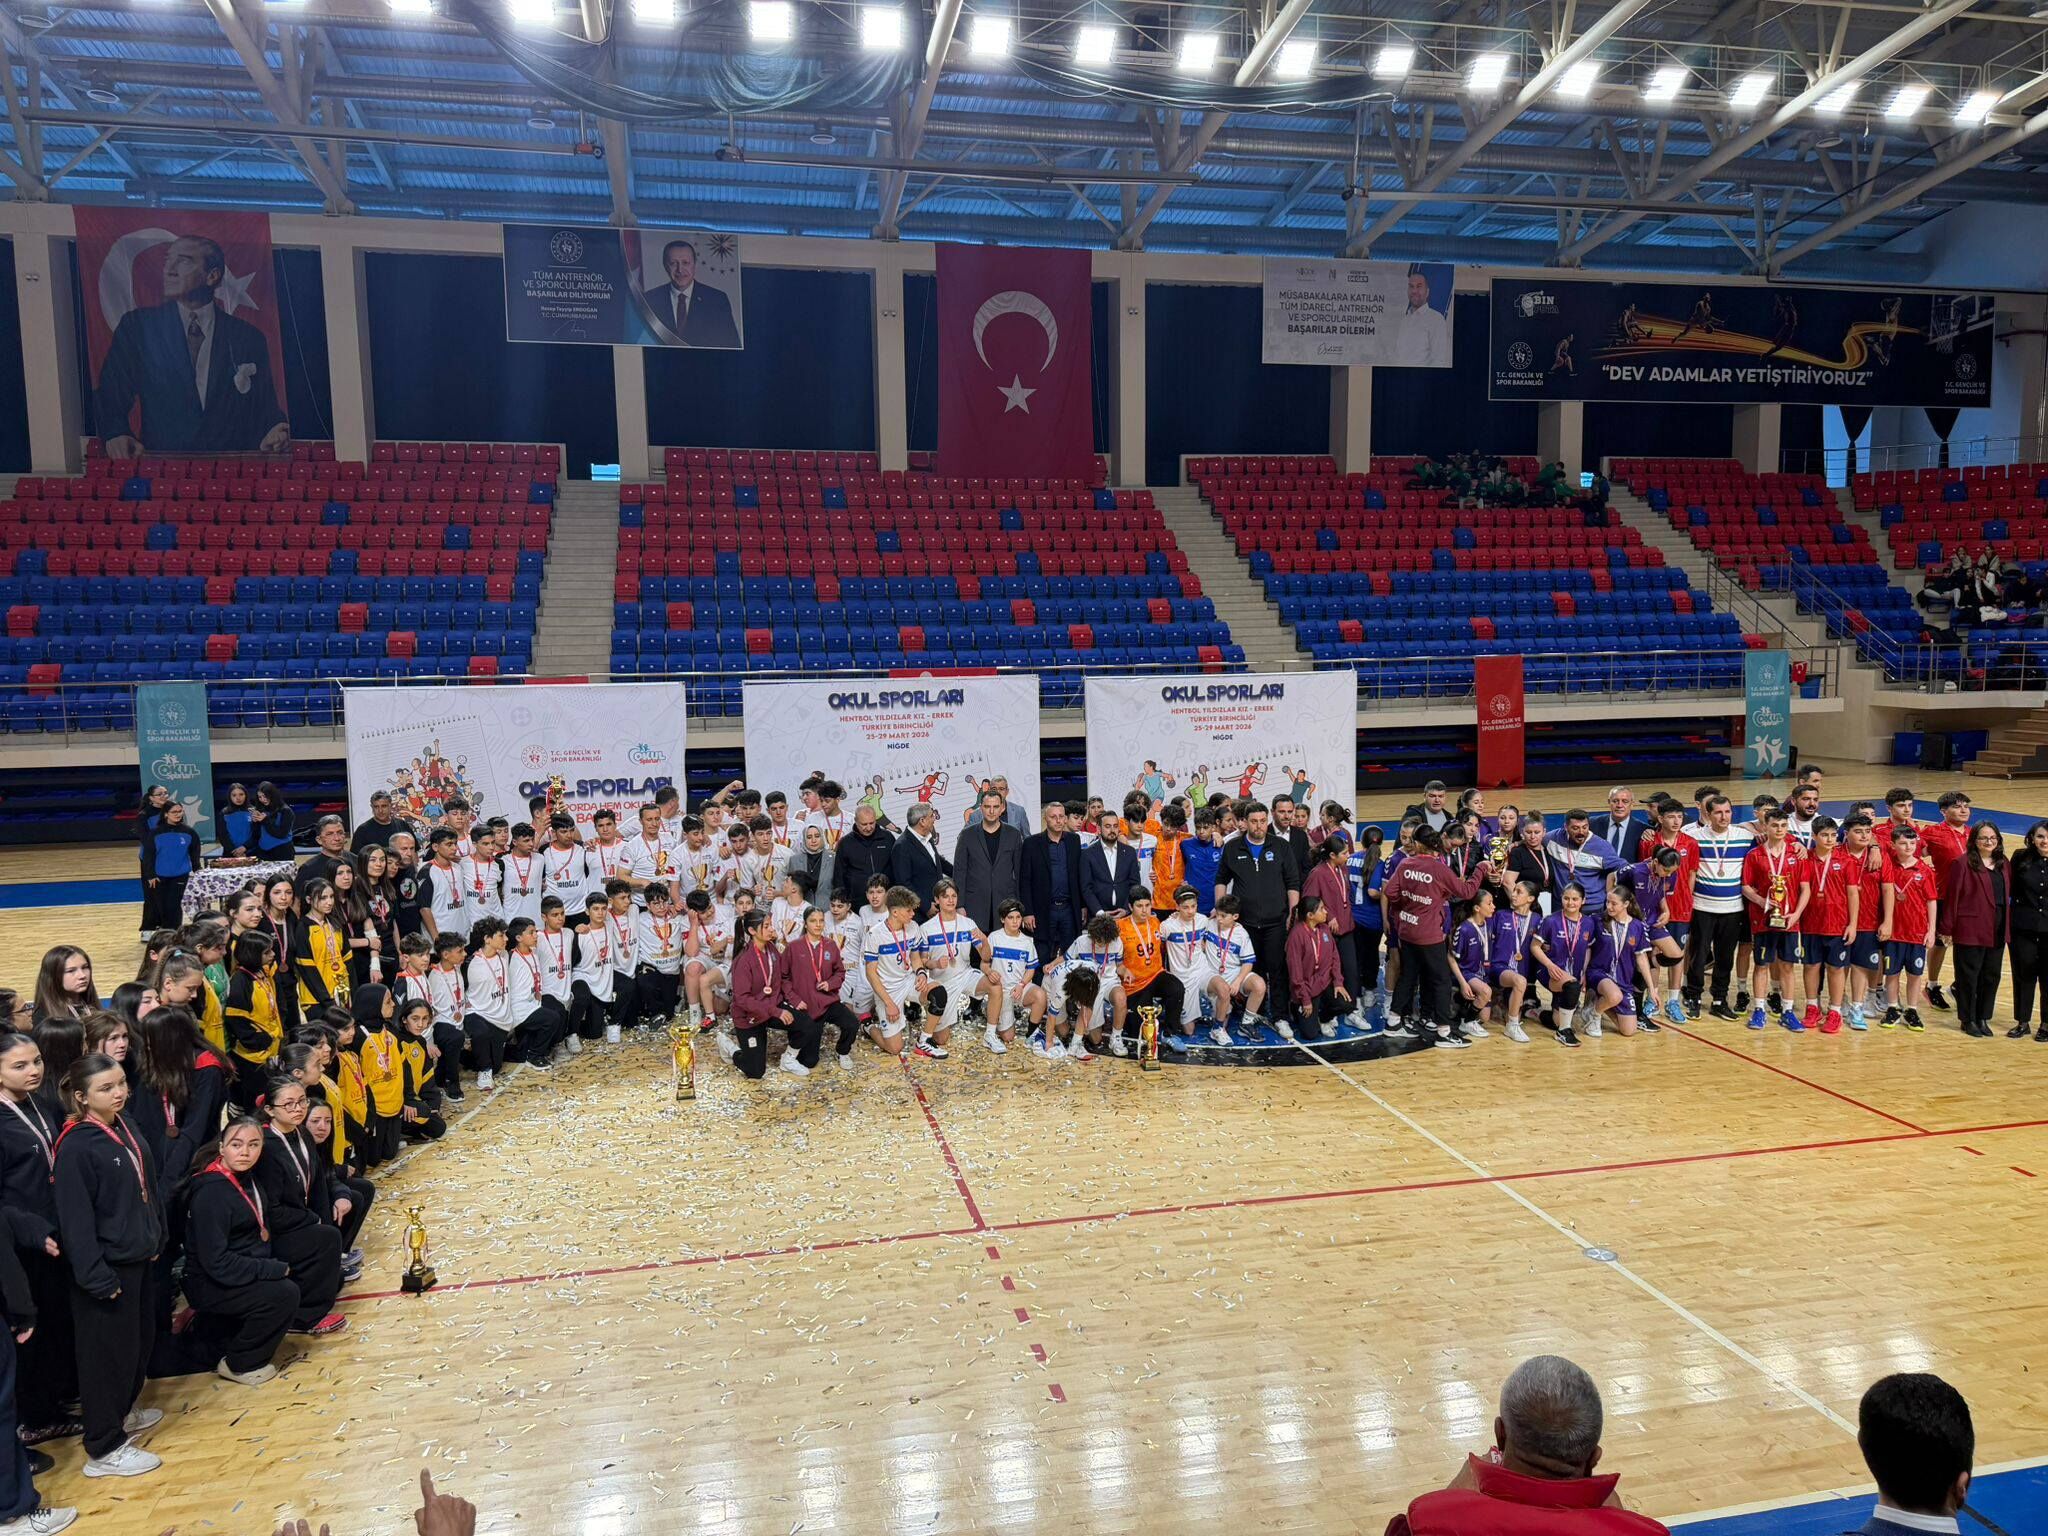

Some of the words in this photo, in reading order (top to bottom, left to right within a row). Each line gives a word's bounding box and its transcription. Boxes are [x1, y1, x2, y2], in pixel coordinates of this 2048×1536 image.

[532, 270, 553, 280] TÜM
[555, 271, 603, 282] ANTRENÖR
[523, 280, 534, 288] VE
[526, 289, 568, 298] BAŞARILAR
[569, 291, 611, 300] DİLİYORUM
[1279, 289, 1348, 301] MÜSABAKALARA
[1350, 293, 1385, 304] KATILAN
[1280, 300, 1298, 310] TÜM
[1300, 301, 1336, 313] İDARECİ,
[1338, 303, 1384, 314] ANTRENÖR
[1288, 313, 1299, 322] VE
[1301, 313, 1375, 324] SPORCULARIMIZA
[1288, 324, 1337, 335] BAŞARILAR
[1340, 325, 1375, 335] DİLERİM
[1649, 366, 1732, 382] ADAMLAR
[1162, 685, 1205, 702] OKUL
[1207, 683, 1284, 701] SPORLARI
[828, 692, 877, 710] OKUL
[879, 689, 964, 708] SPORLARI
[1218, 714, 1256, 722] BİRİNCİLİĞİ
[893, 721, 934, 729] BİRİNCİLİĞİ
[887, 742, 910, 750] NİĞDE
[568, 755, 602, 763] BAKANLIĞI
[634, 750, 666, 761] OKUL
[158, 763, 200, 776] OKUL
[599, 802, 622, 811] HEM
[1403, 869, 1433, 883] ONKO
[1350, 874, 1363, 904] 7
[1007, 962, 1013, 973] 3
